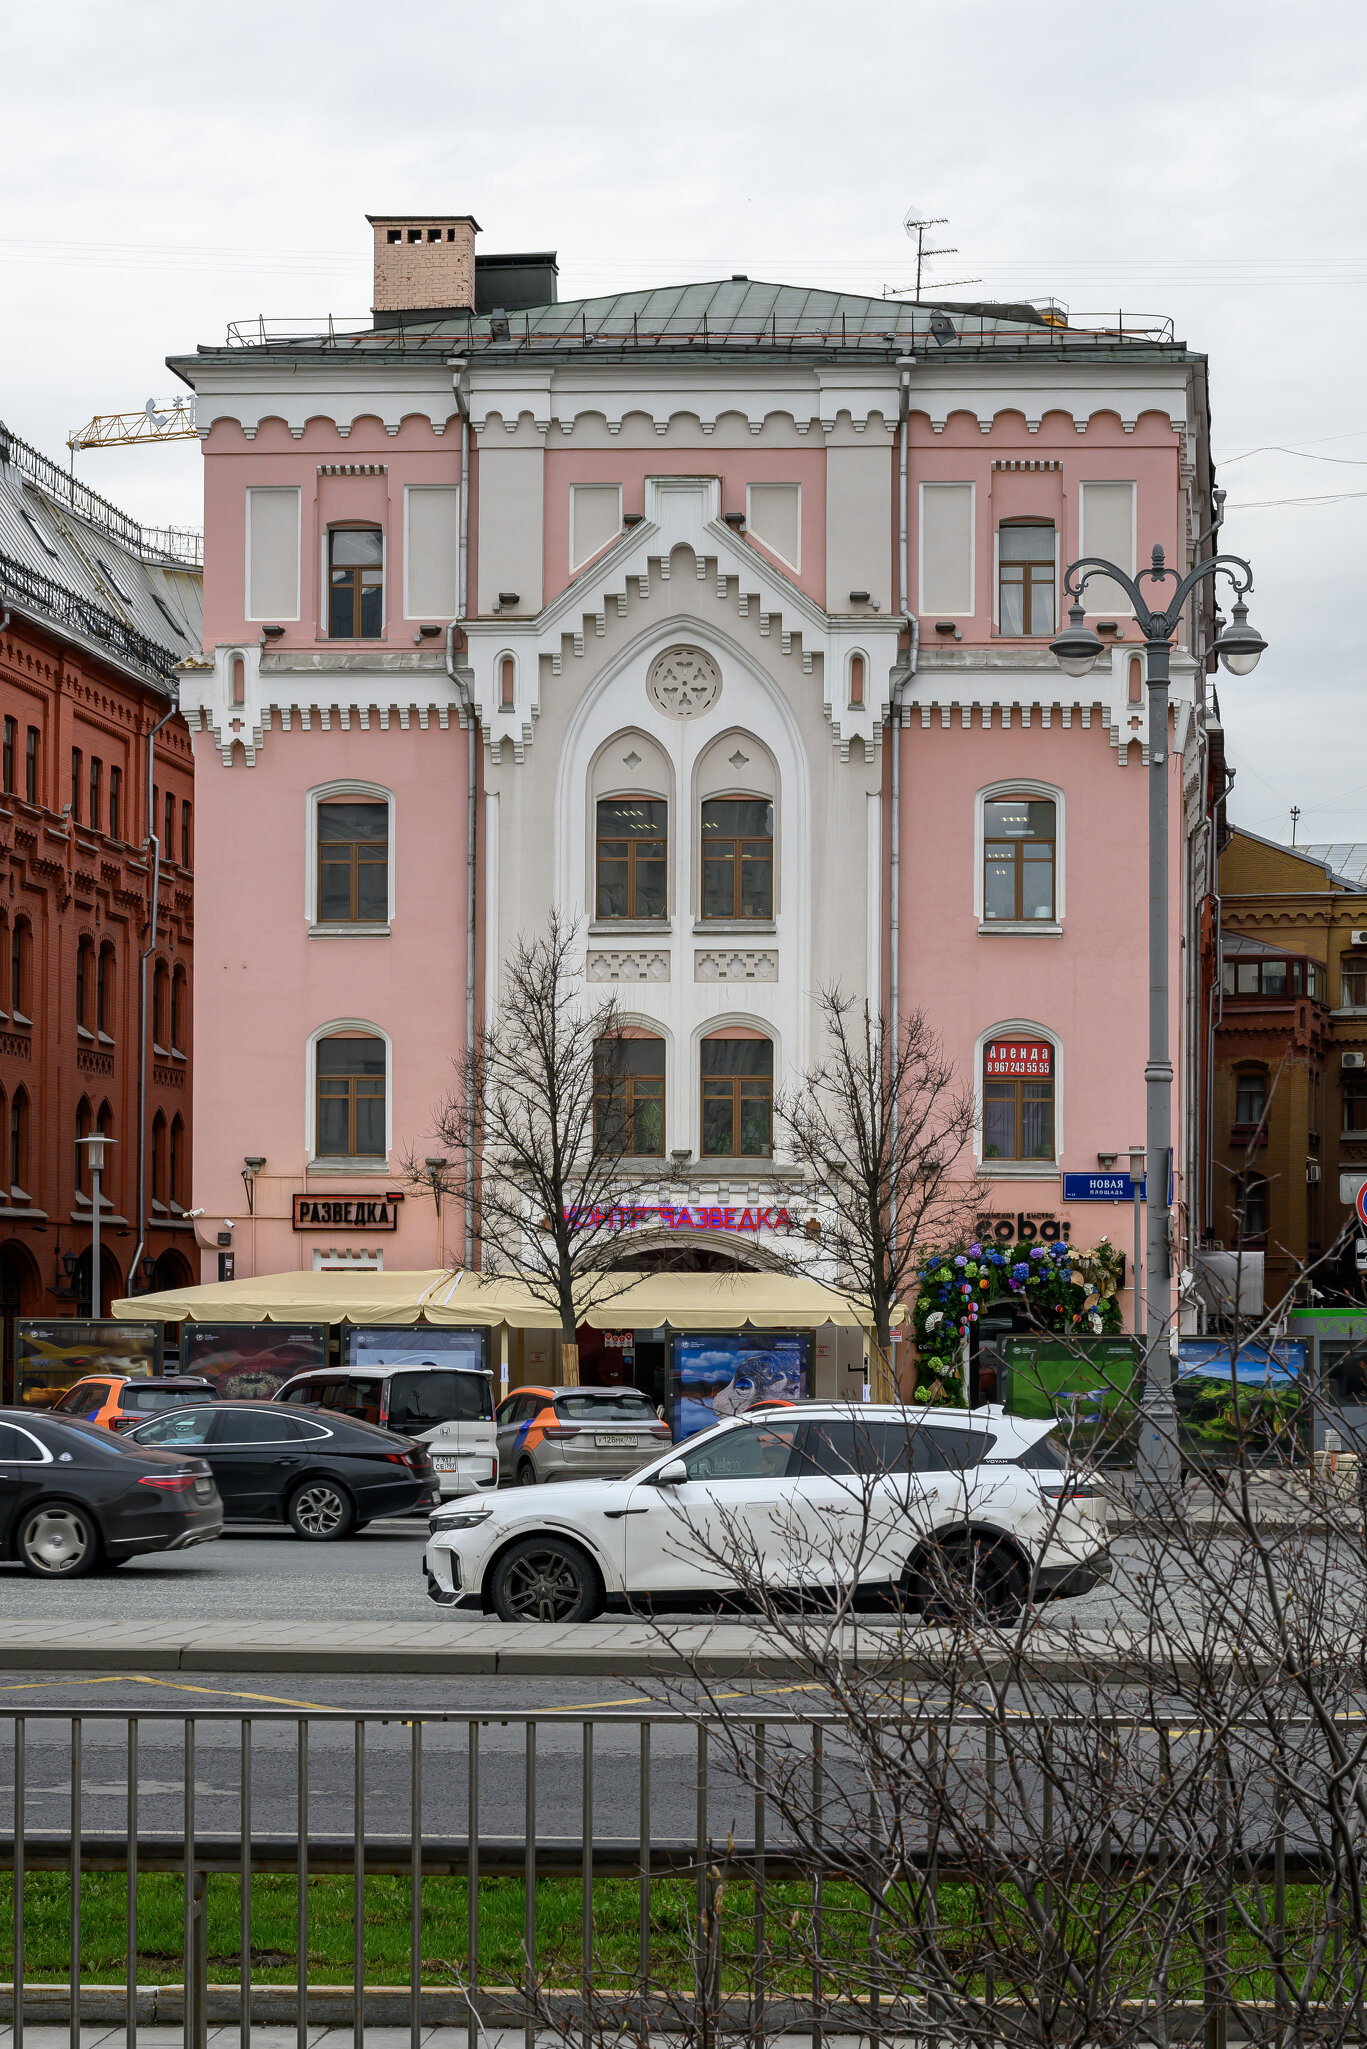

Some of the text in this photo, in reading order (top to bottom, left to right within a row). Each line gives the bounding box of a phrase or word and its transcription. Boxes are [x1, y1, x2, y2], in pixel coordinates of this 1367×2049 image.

[990, 1045, 1048, 1061] Аренда
[987, 1062, 1049, 1073] 8 967 243 55 55
[1089, 1179, 1124, 1189] НОВАЯ
[300, 1202, 389, 1225] РАЗВЕДКА
